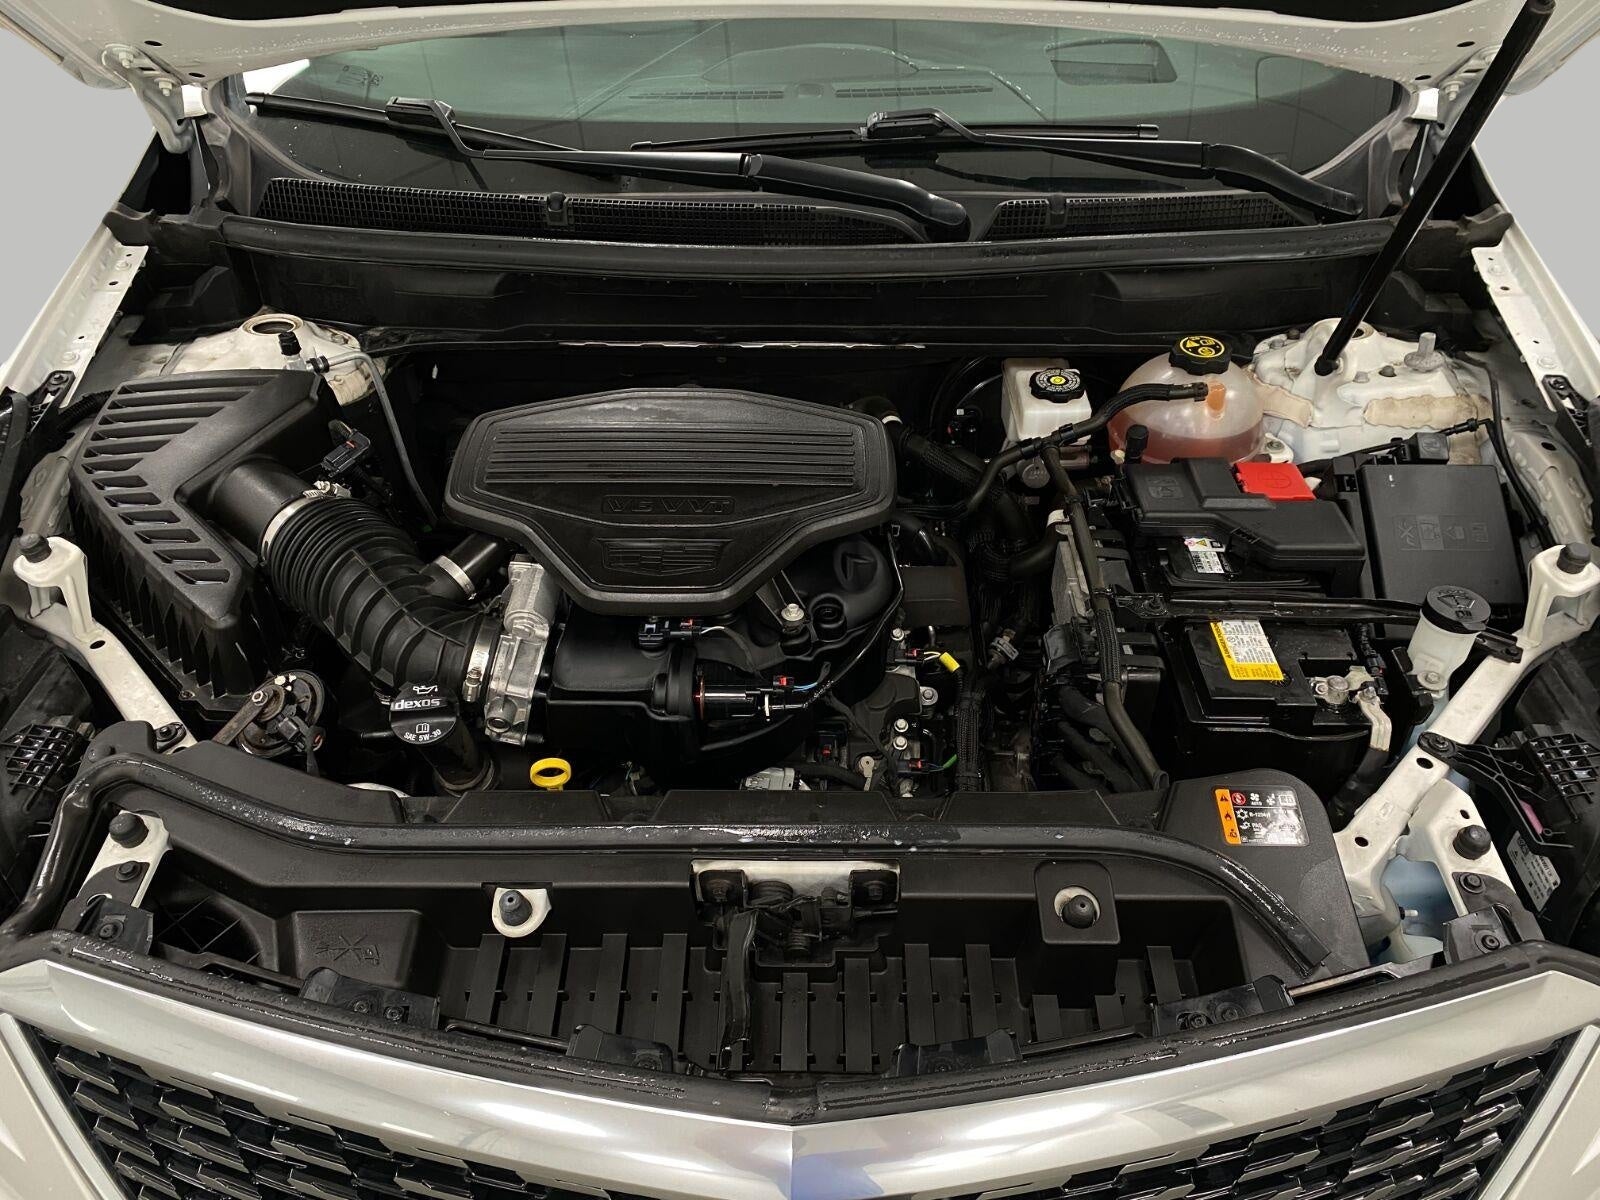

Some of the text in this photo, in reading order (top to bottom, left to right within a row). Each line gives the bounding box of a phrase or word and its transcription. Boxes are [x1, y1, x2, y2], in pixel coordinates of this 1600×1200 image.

[661, 499, 730, 513] VVT
[395, 698, 441, 709] dexos
[404, 728, 442, 742] SAE 5W-30
